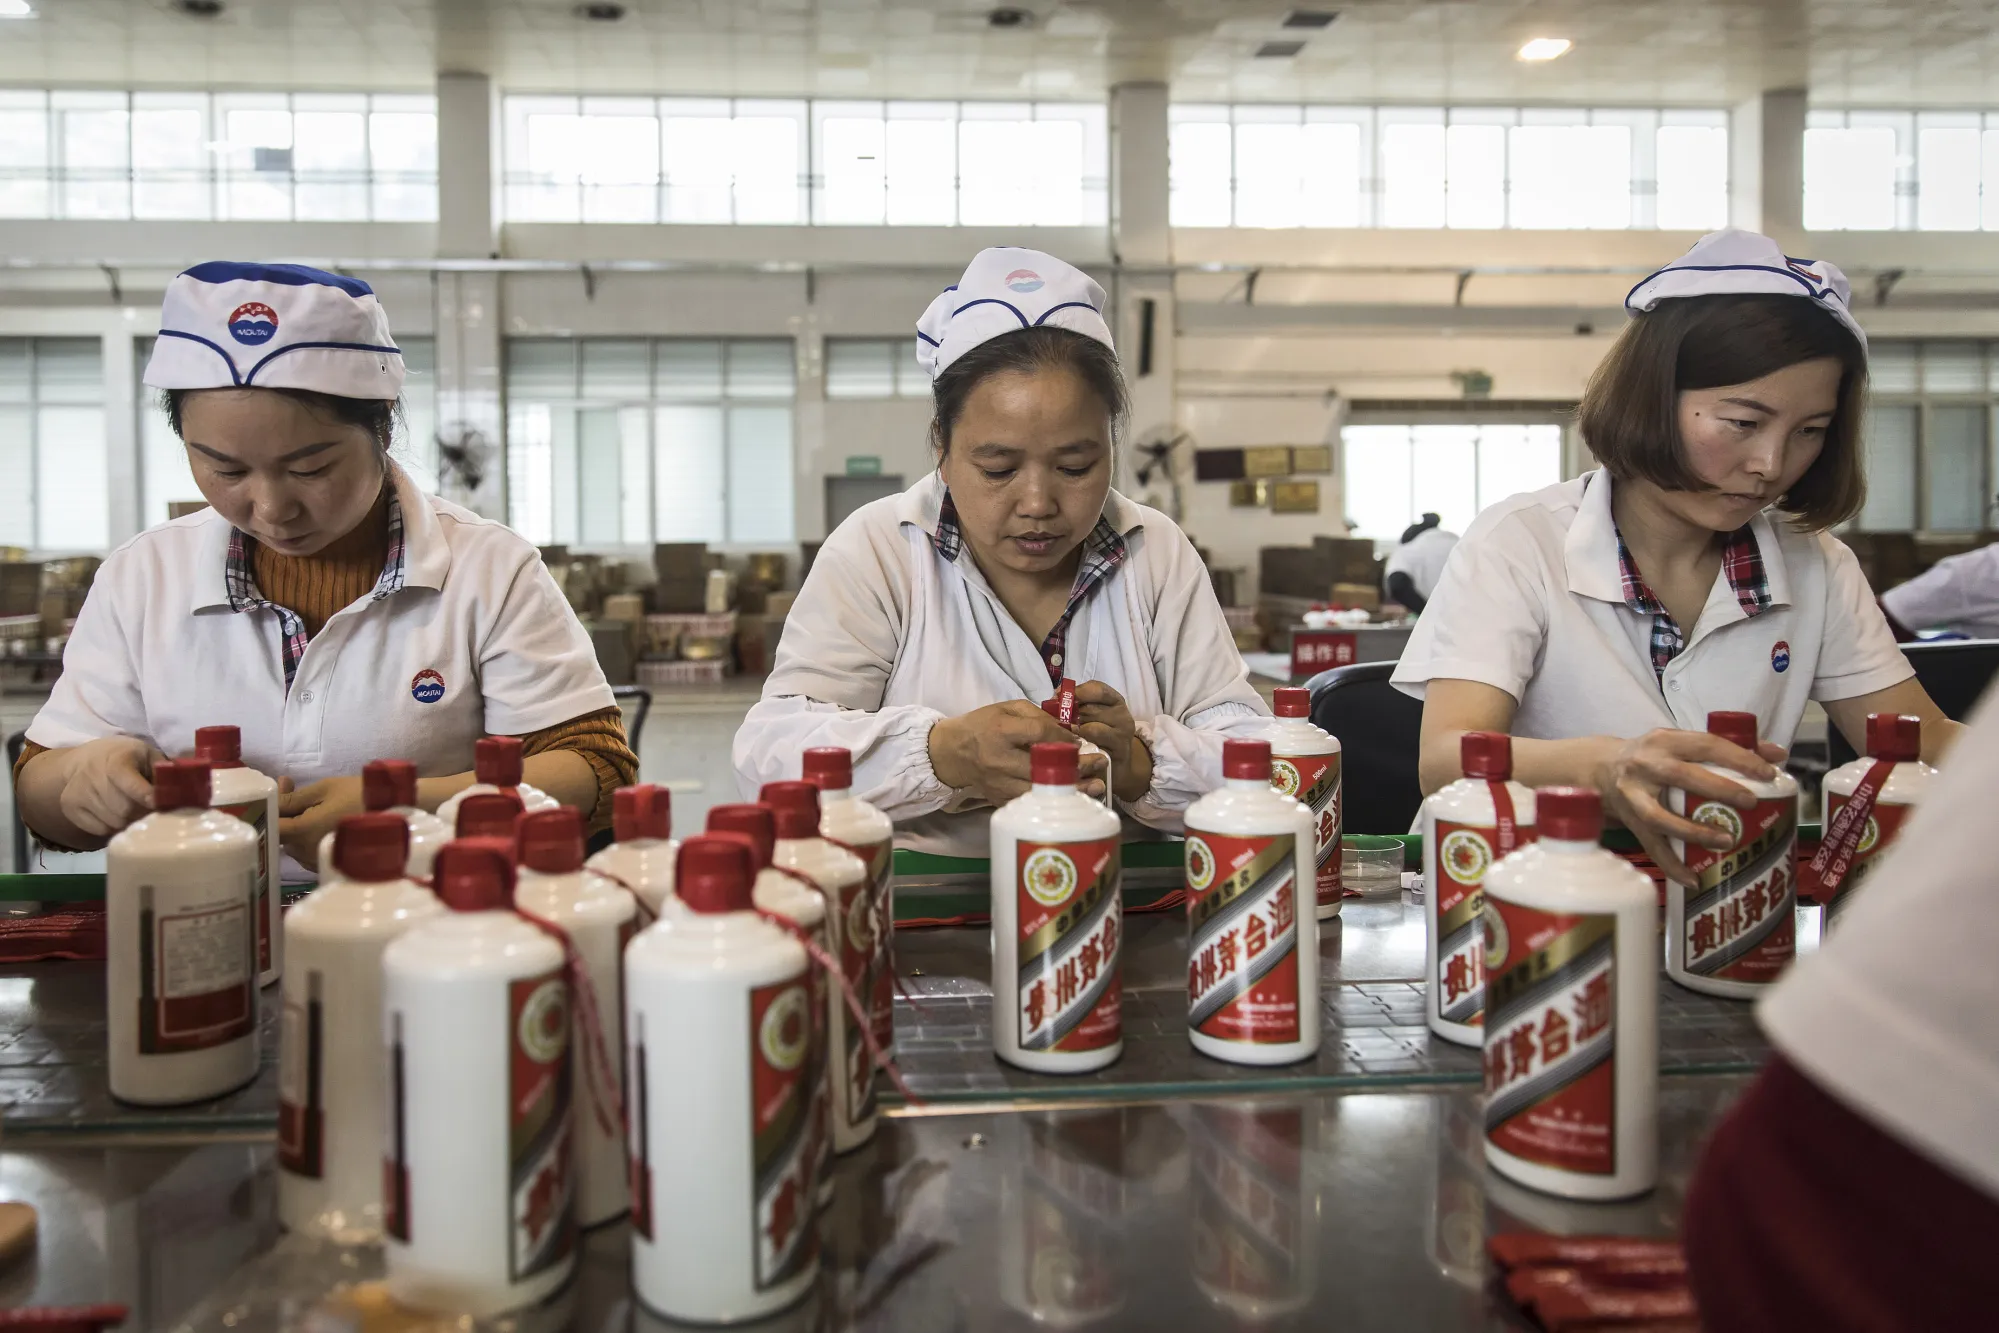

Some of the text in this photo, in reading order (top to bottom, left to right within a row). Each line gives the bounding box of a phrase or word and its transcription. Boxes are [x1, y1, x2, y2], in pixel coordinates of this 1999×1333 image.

[1296, 643, 1353, 664] 操作台
[1312, 763, 1328, 781] 500ml
[1022, 898, 1121, 1034] 贵州茅台
